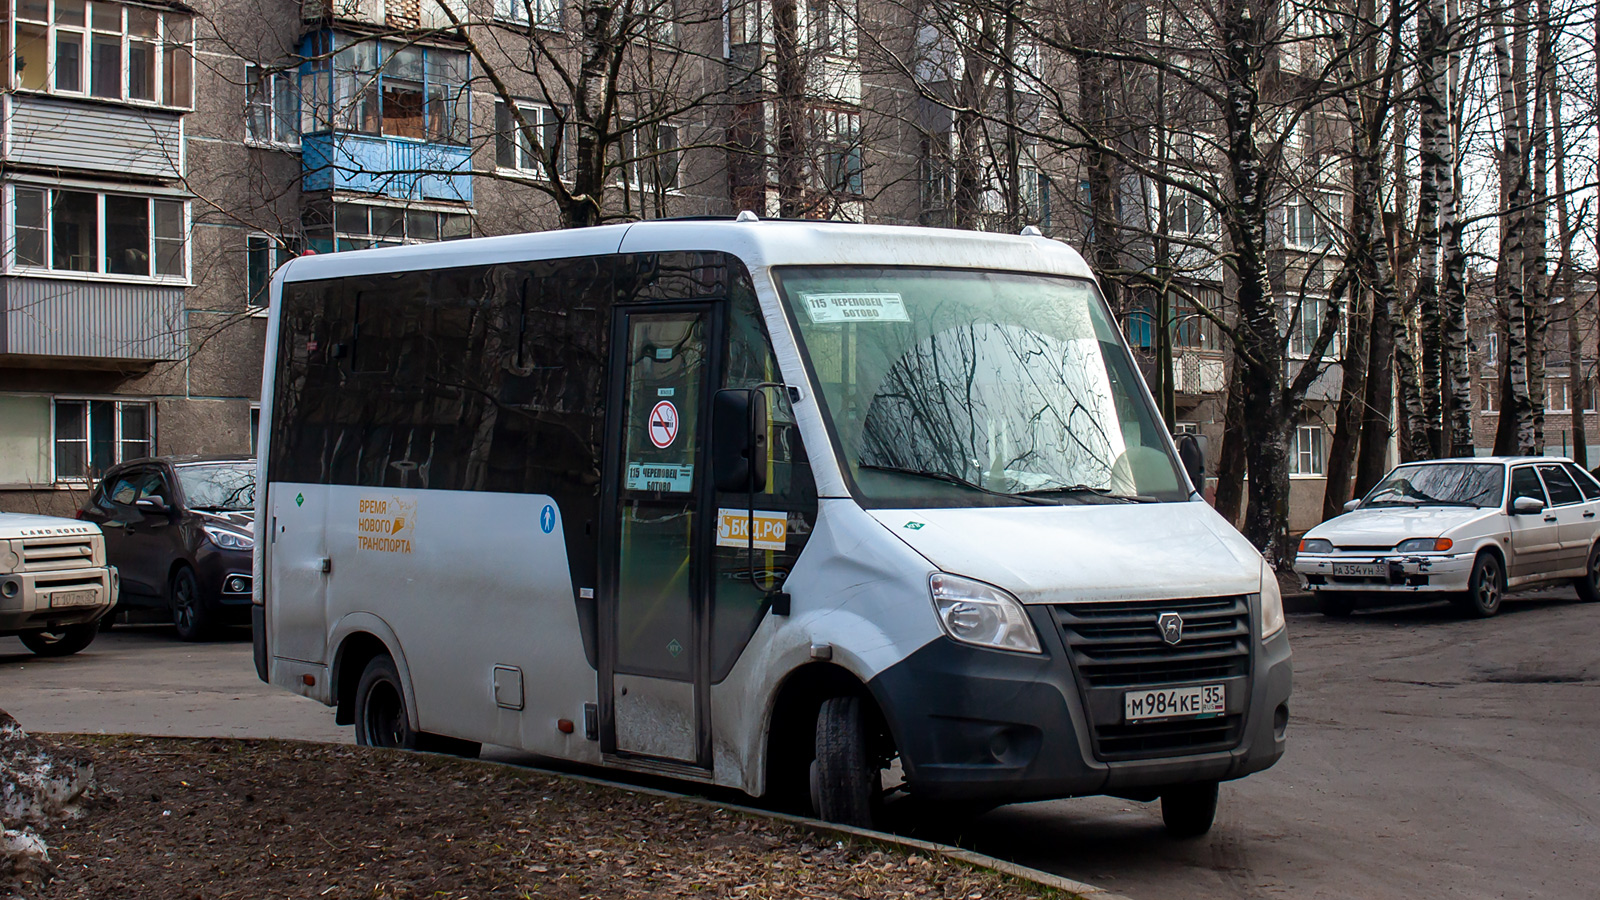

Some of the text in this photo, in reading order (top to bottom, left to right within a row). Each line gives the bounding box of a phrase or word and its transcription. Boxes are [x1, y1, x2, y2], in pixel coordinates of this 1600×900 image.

[809, 298, 828, 308] 115
[830, 297, 883, 307] ЧЕРЕПОВЕЦ
[842, 309, 879, 317] БОТОВО
[629, 467, 640, 478] 115
[642, 467, 678, 480] ЧЕРЕПОВЕЦ
[646, 481, 671, 492] БОТОВО
[359, 499, 387, 514] ВРЕМЯ
[358, 518, 391, 533] НОВОГО
[358, 535, 412, 554] ТРАНСПОРТА
[1337, 565, 1374, 575] А354УН
[1132, 686, 1220, 716] М984КЕ 35
